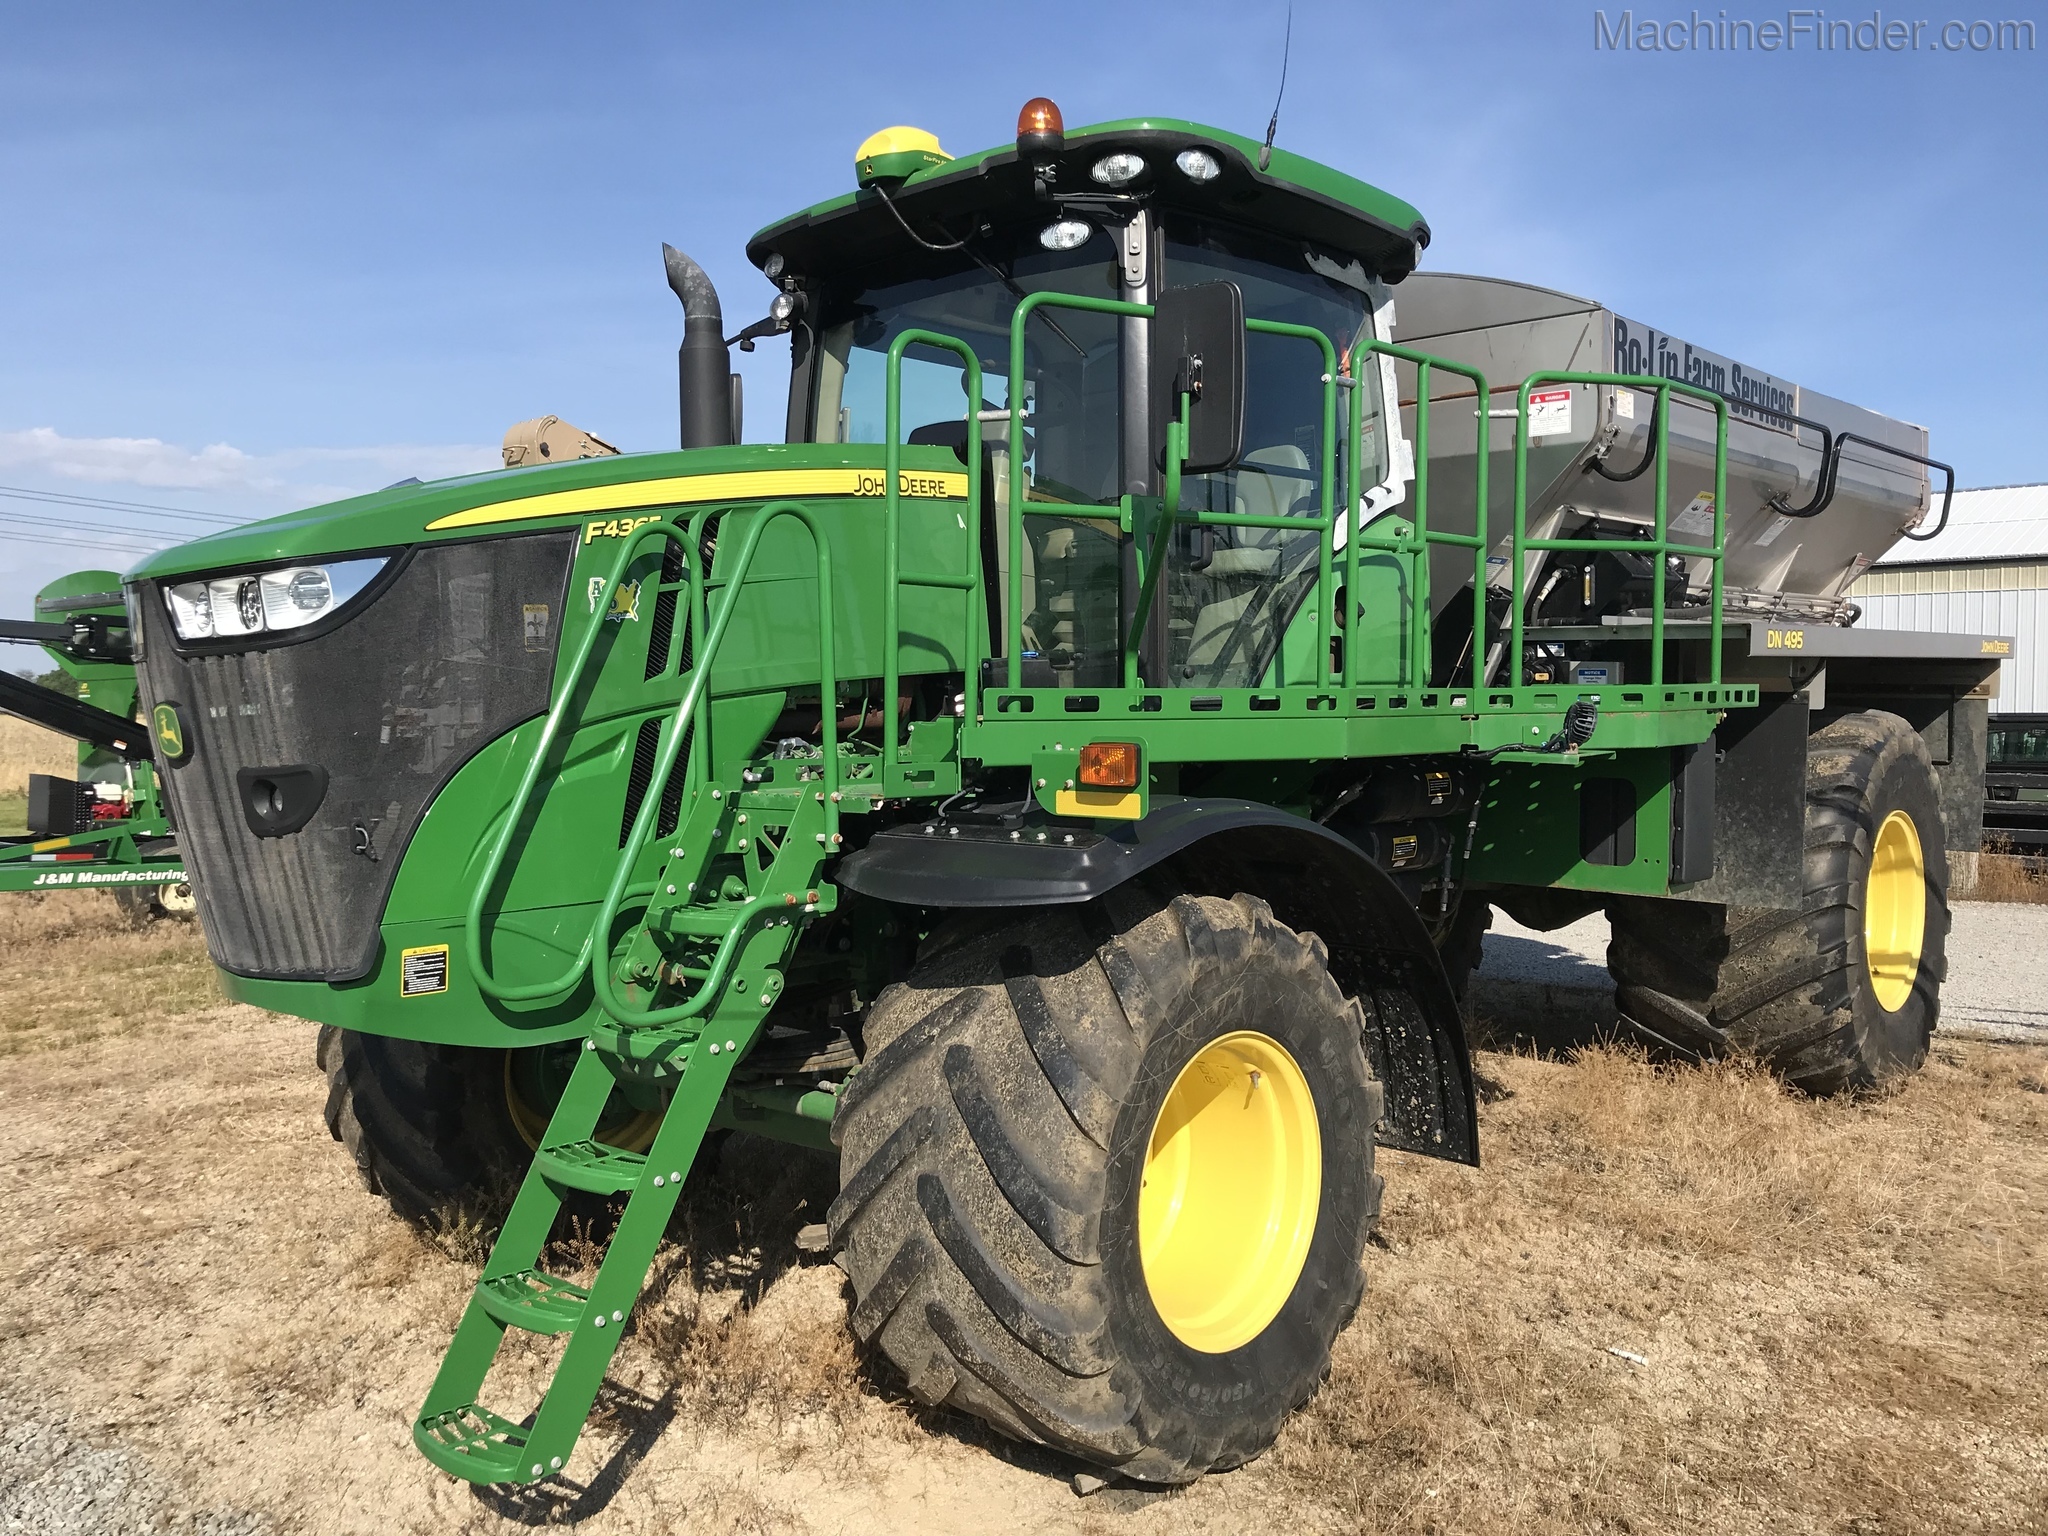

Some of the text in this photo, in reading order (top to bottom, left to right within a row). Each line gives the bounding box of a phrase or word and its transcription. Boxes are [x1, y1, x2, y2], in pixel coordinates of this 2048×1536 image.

[1684, 343, 1726, 394] Farm
[1730, 362, 1794, 433] Services
[853, 473, 947, 495] JOH DEERE
[584, 515, 662, 545] F43
[1767, 629, 1804, 649] DN 495
[33, 869, 189, 885] J&M Manufacturing
